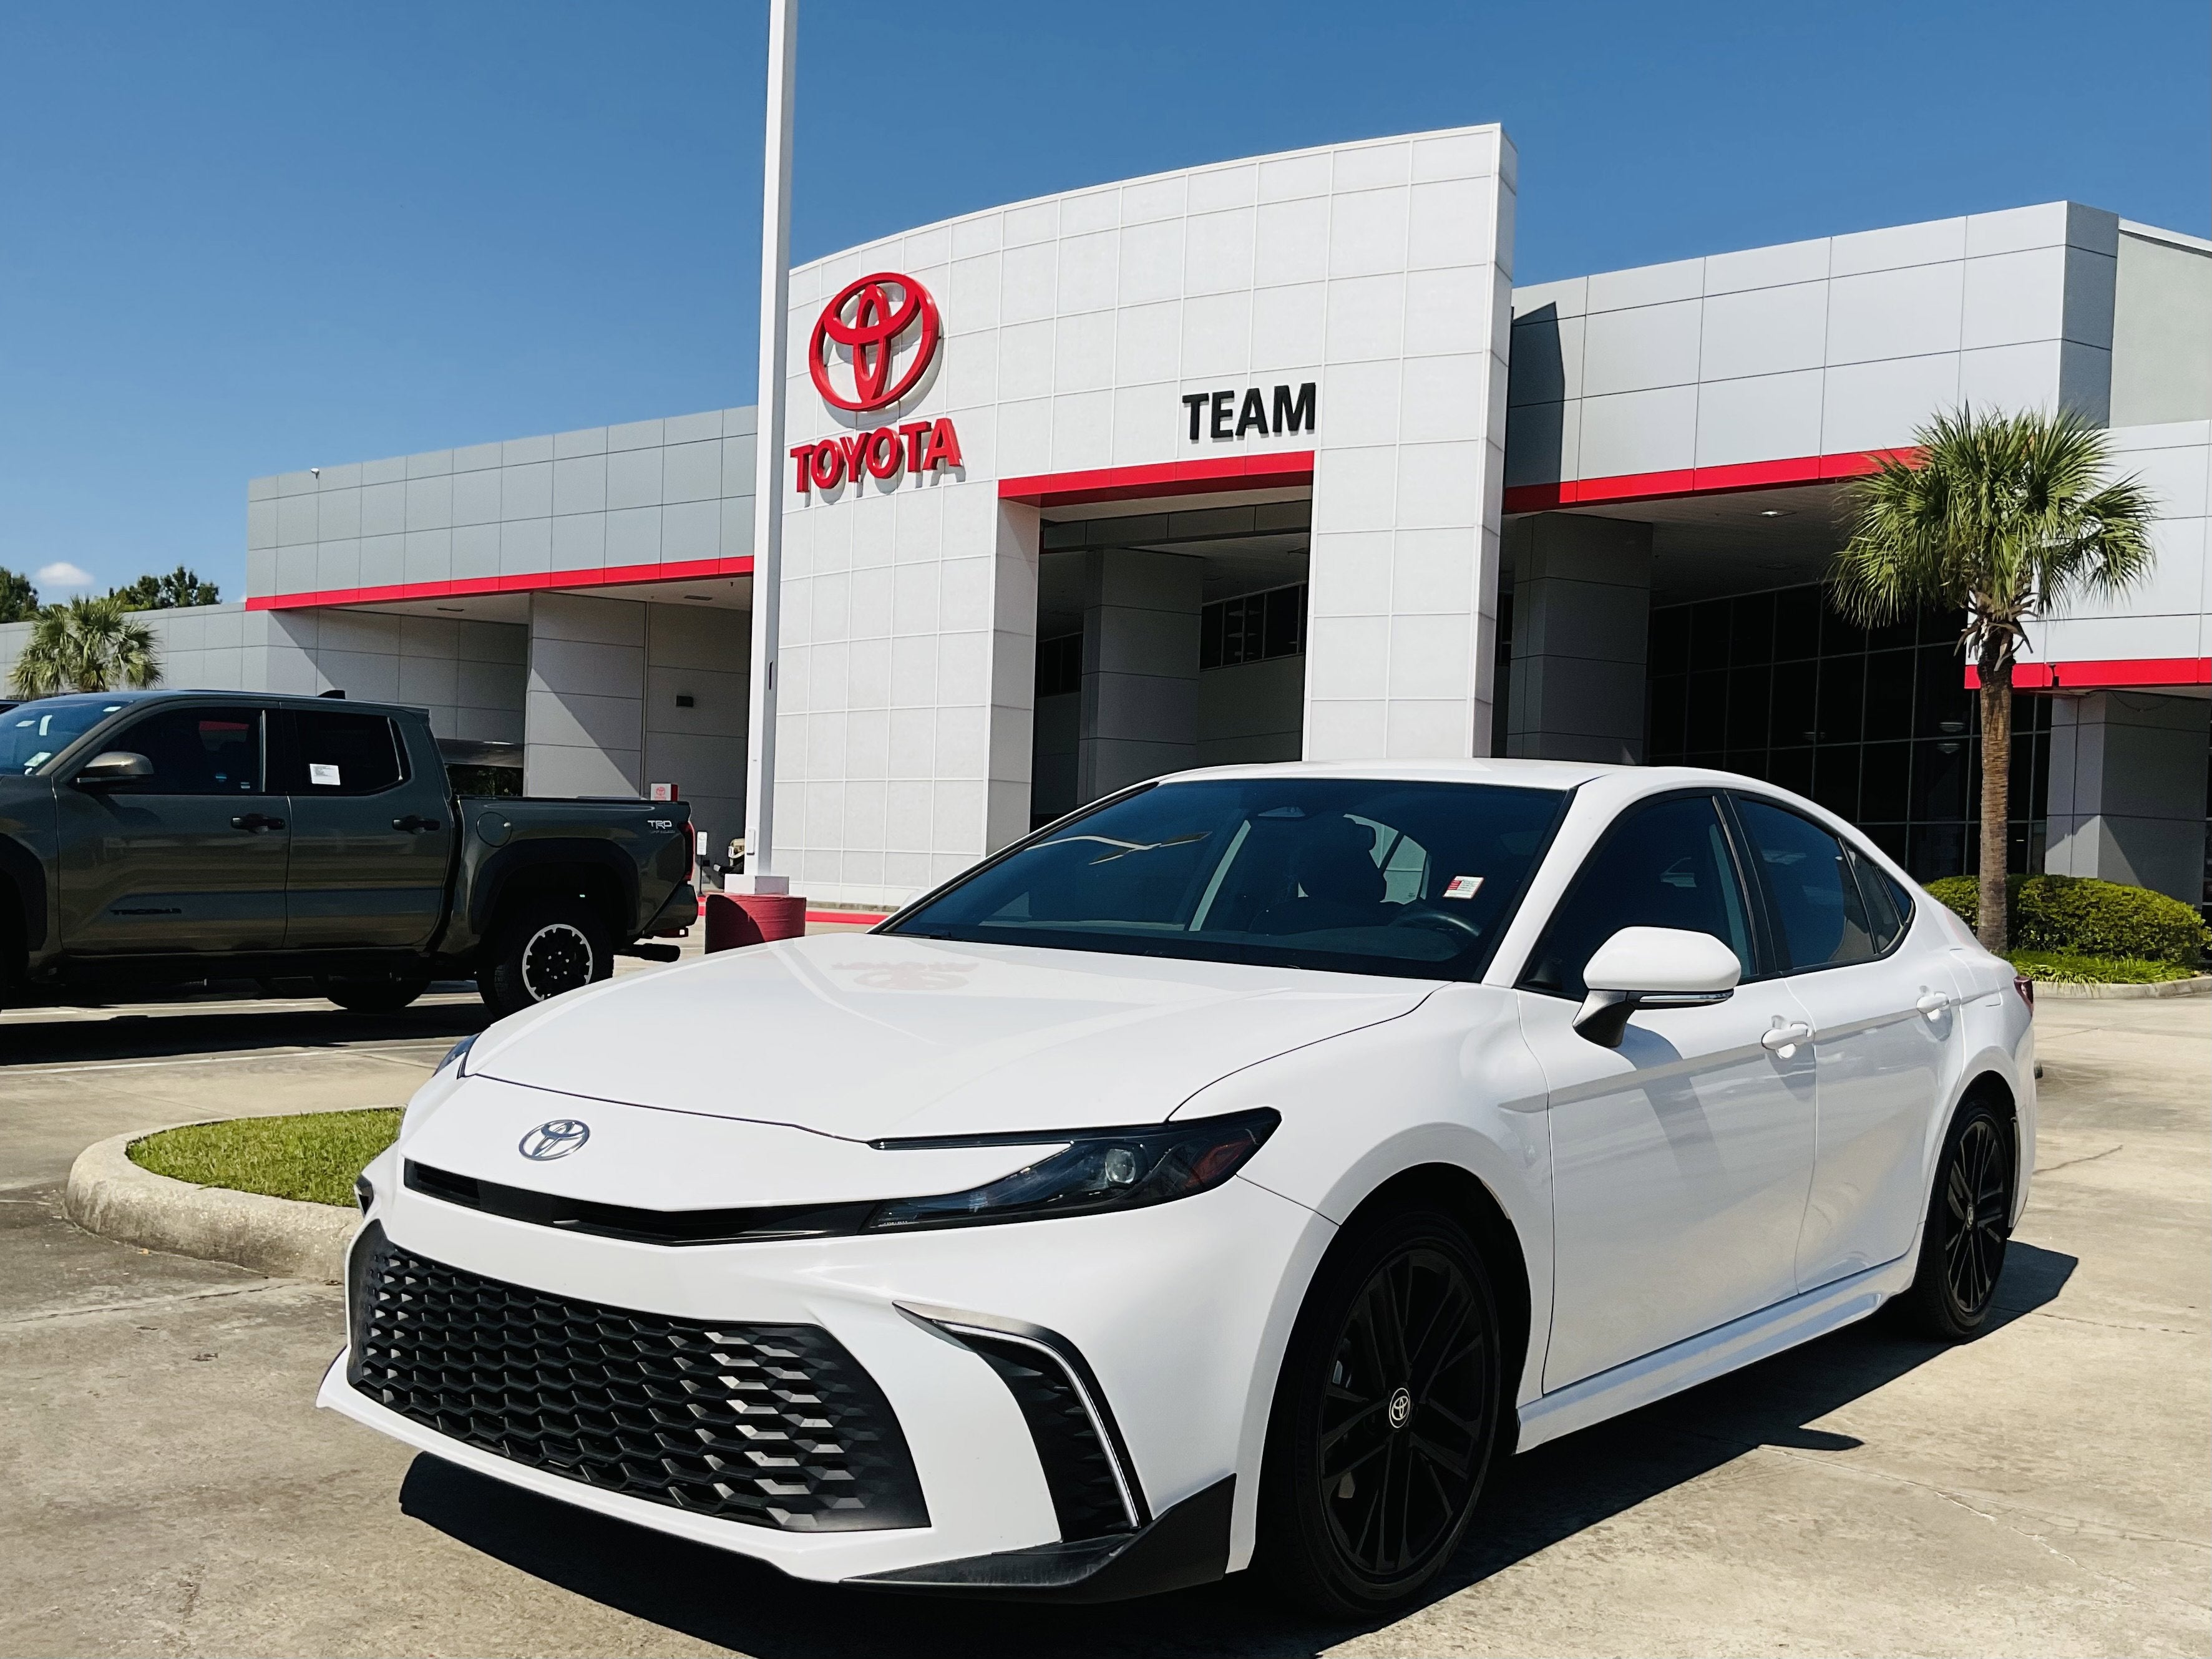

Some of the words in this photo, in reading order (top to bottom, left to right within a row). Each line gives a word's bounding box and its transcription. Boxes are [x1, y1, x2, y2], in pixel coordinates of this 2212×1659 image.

[1182, 382, 1316, 440] TEAM
[790, 417, 962, 493] TOYOTA
[647, 820, 672, 829] TRD
